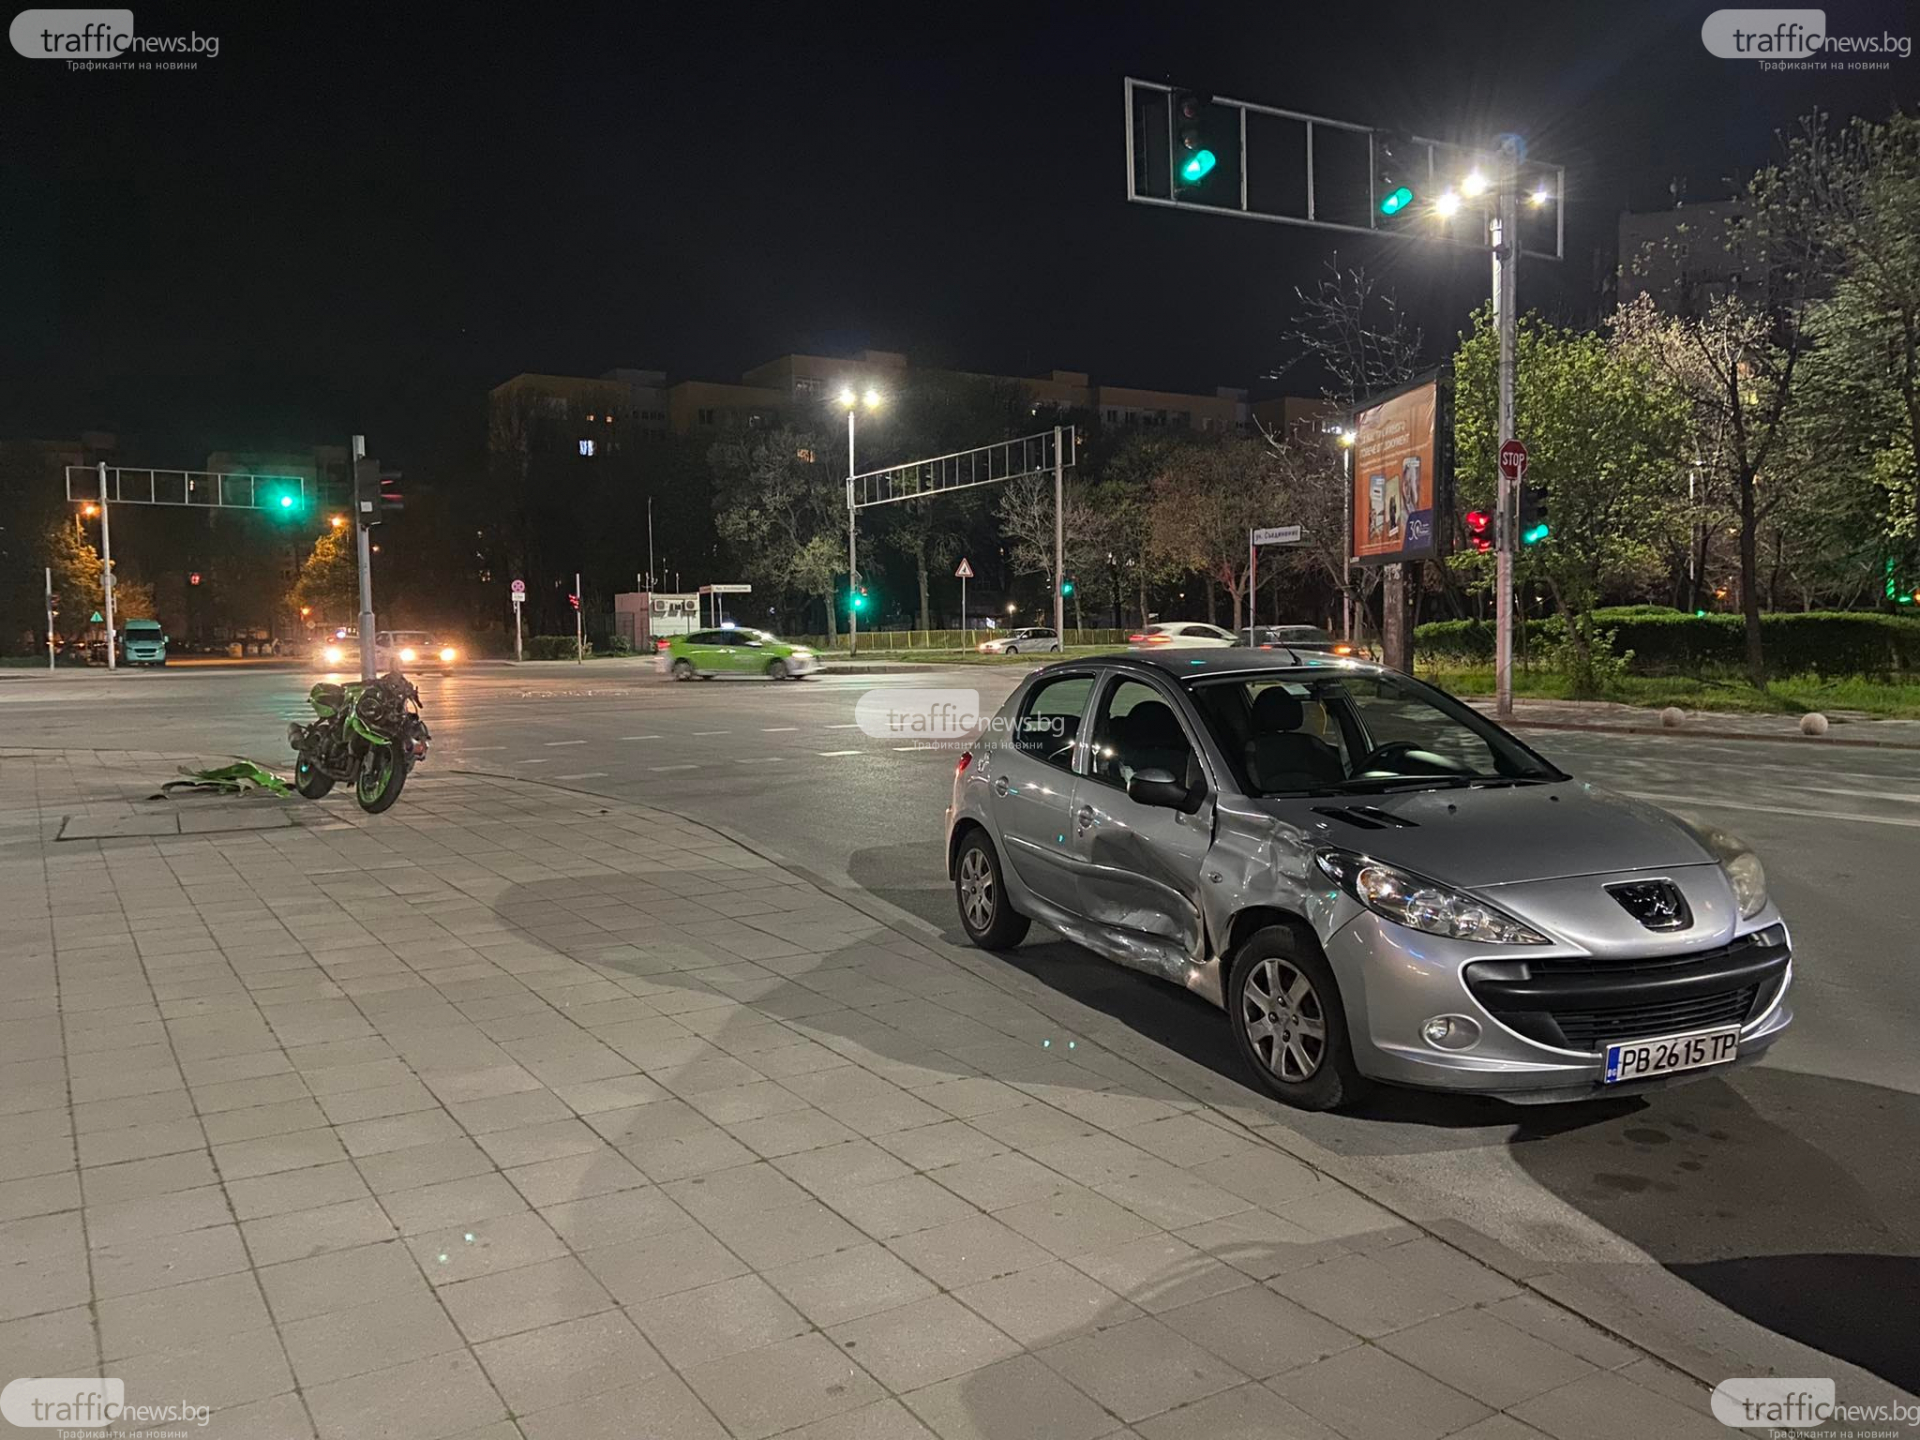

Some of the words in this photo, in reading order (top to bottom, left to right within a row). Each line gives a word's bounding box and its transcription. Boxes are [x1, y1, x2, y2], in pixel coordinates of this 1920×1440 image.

[1502, 451, 1525, 466] STOP
[1620, 1047, 1650, 1076] PB
[1653, 1038, 1706, 1070] 2615
[1711, 1033, 1736, 1060] TP
